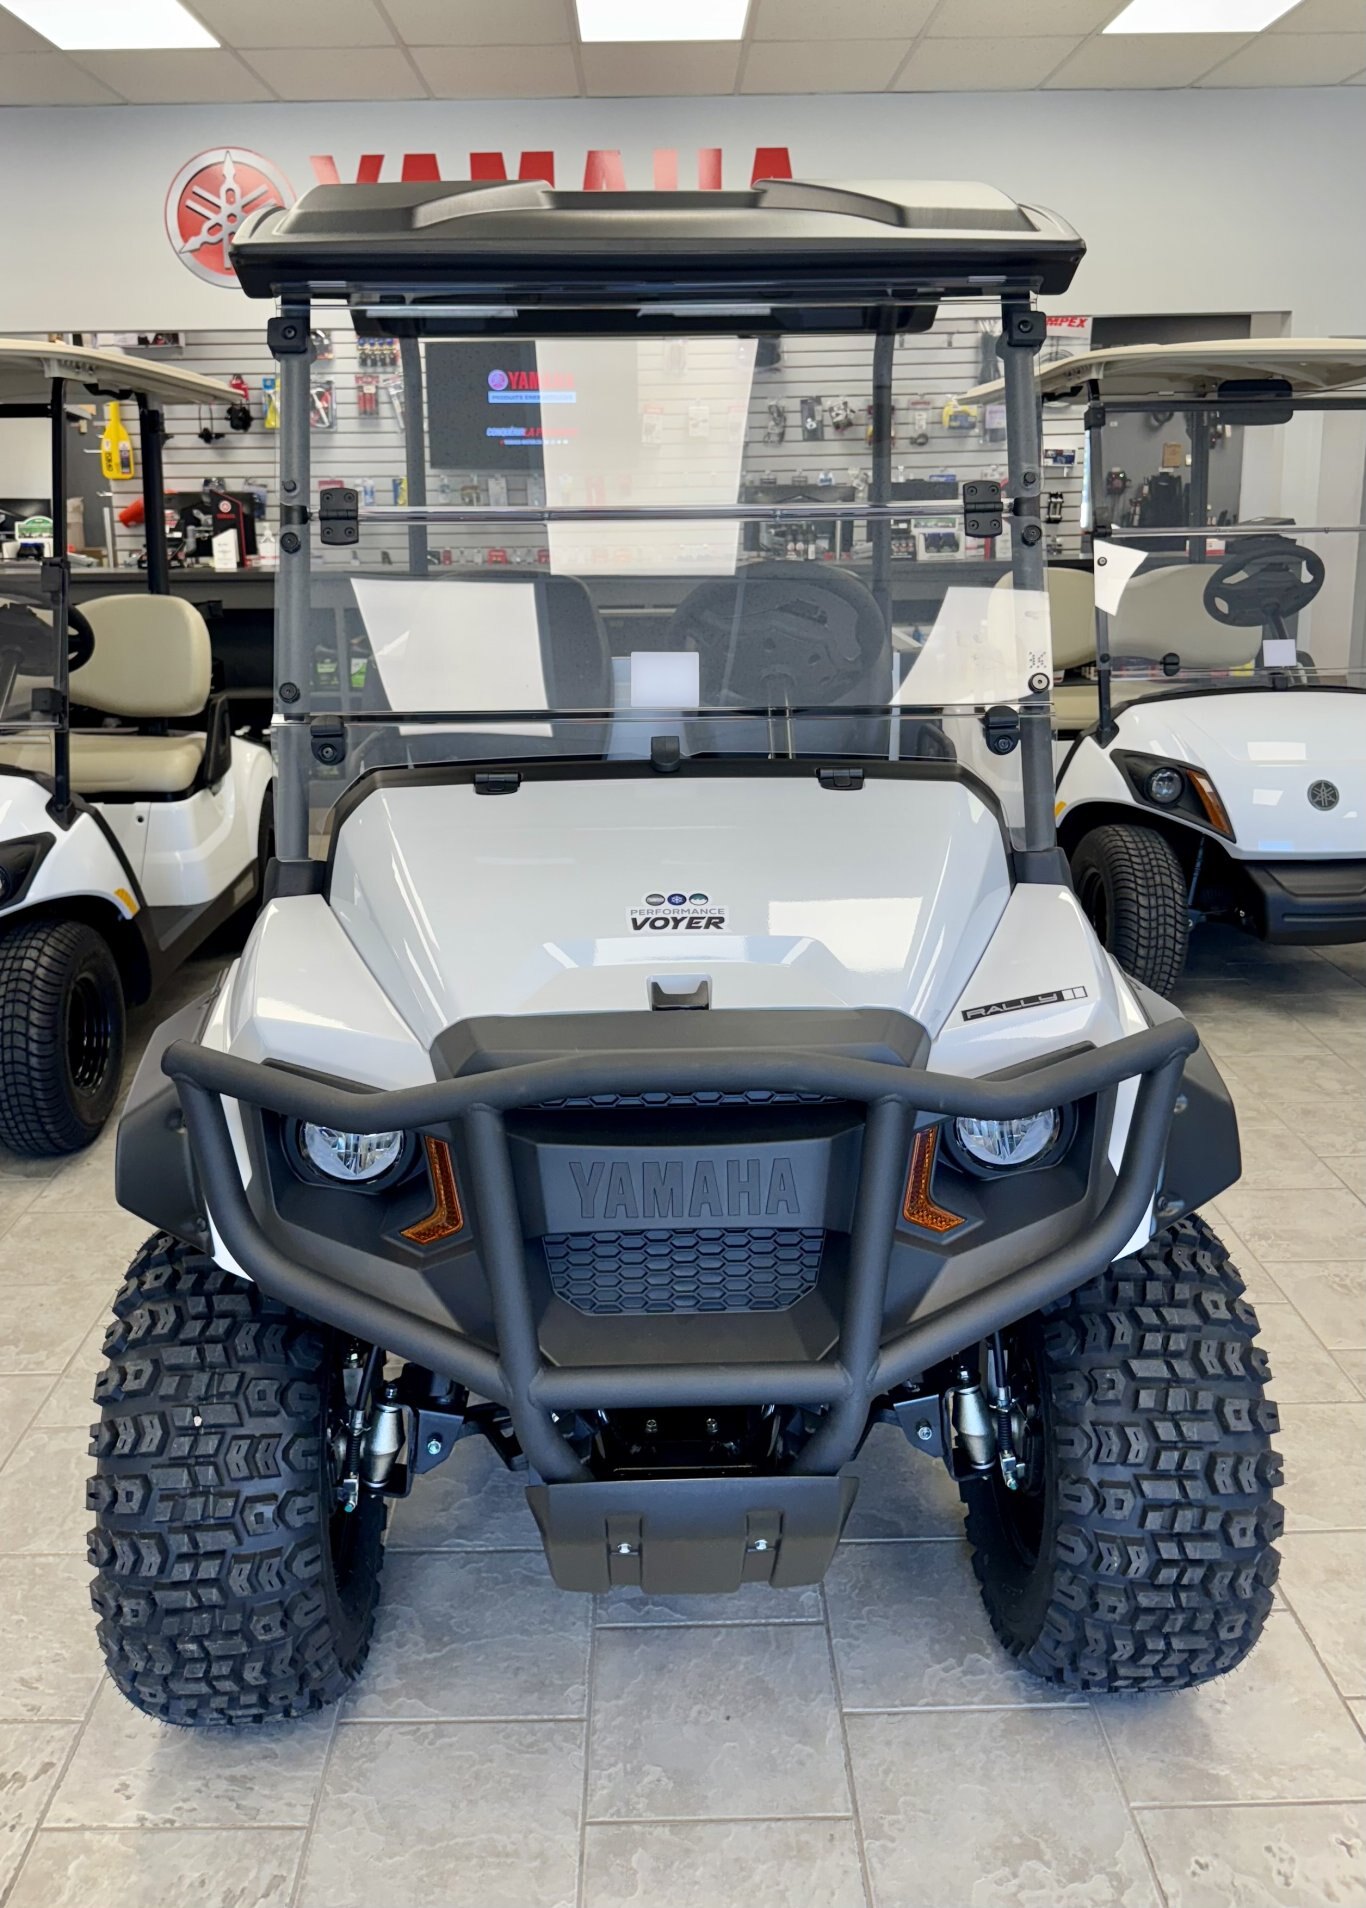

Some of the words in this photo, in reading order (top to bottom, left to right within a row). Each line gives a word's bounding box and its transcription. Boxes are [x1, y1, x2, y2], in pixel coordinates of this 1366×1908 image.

[1045, 316, 1088, 328] MPEX
[630, 908, 725, 916] PERFORMANCE
[631, 916, 725, 931] VOYER
[966, 993, 1058, 1019] RALLY
[568, 1157, 801, 1218] YAMAHA
